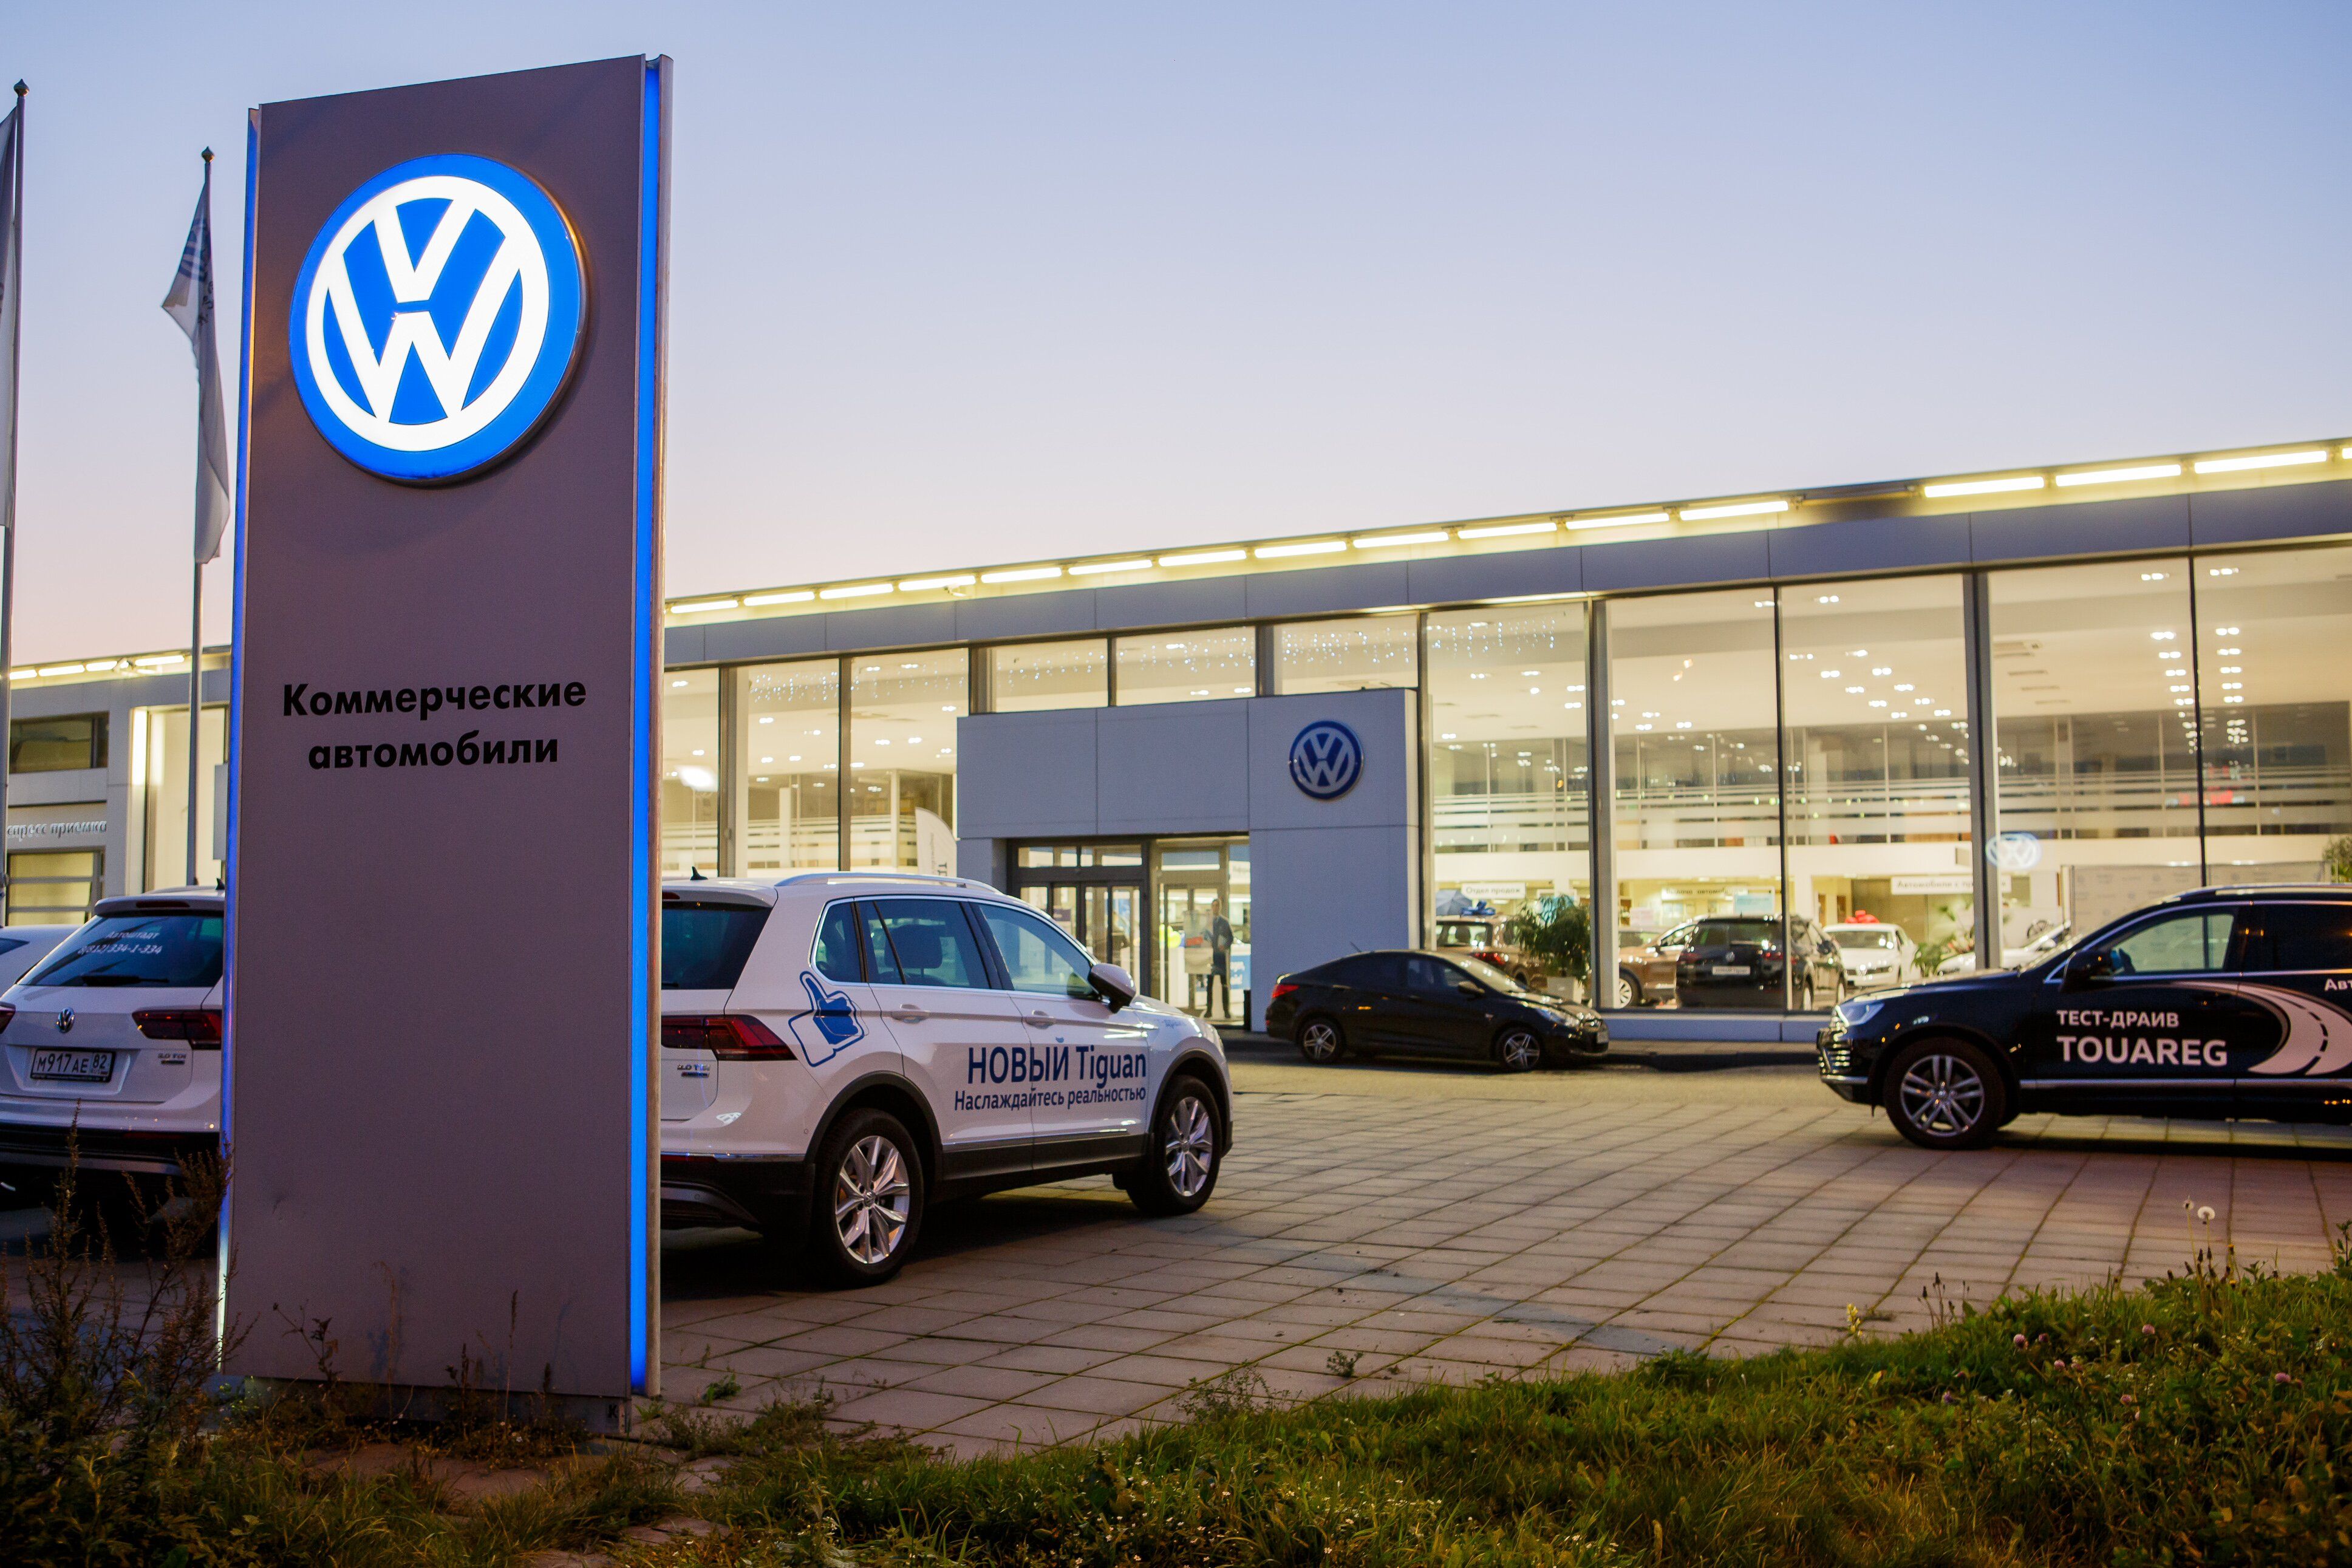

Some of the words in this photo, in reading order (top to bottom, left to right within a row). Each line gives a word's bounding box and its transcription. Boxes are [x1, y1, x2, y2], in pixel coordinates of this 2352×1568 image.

[283, 681, 586, 721] Коммерческие
[308, 729, 558, 770] автомобили
[6, 824, 47, 842] спресс
[1075, 1045, 1147, 1089] Tiguan
[2056, 1035, 2228, 1067] TOUAREG
[954, 1088, 1064, 1111] Наслаждайтесь
[1067, 1087, 1147, 1110] реальностью
